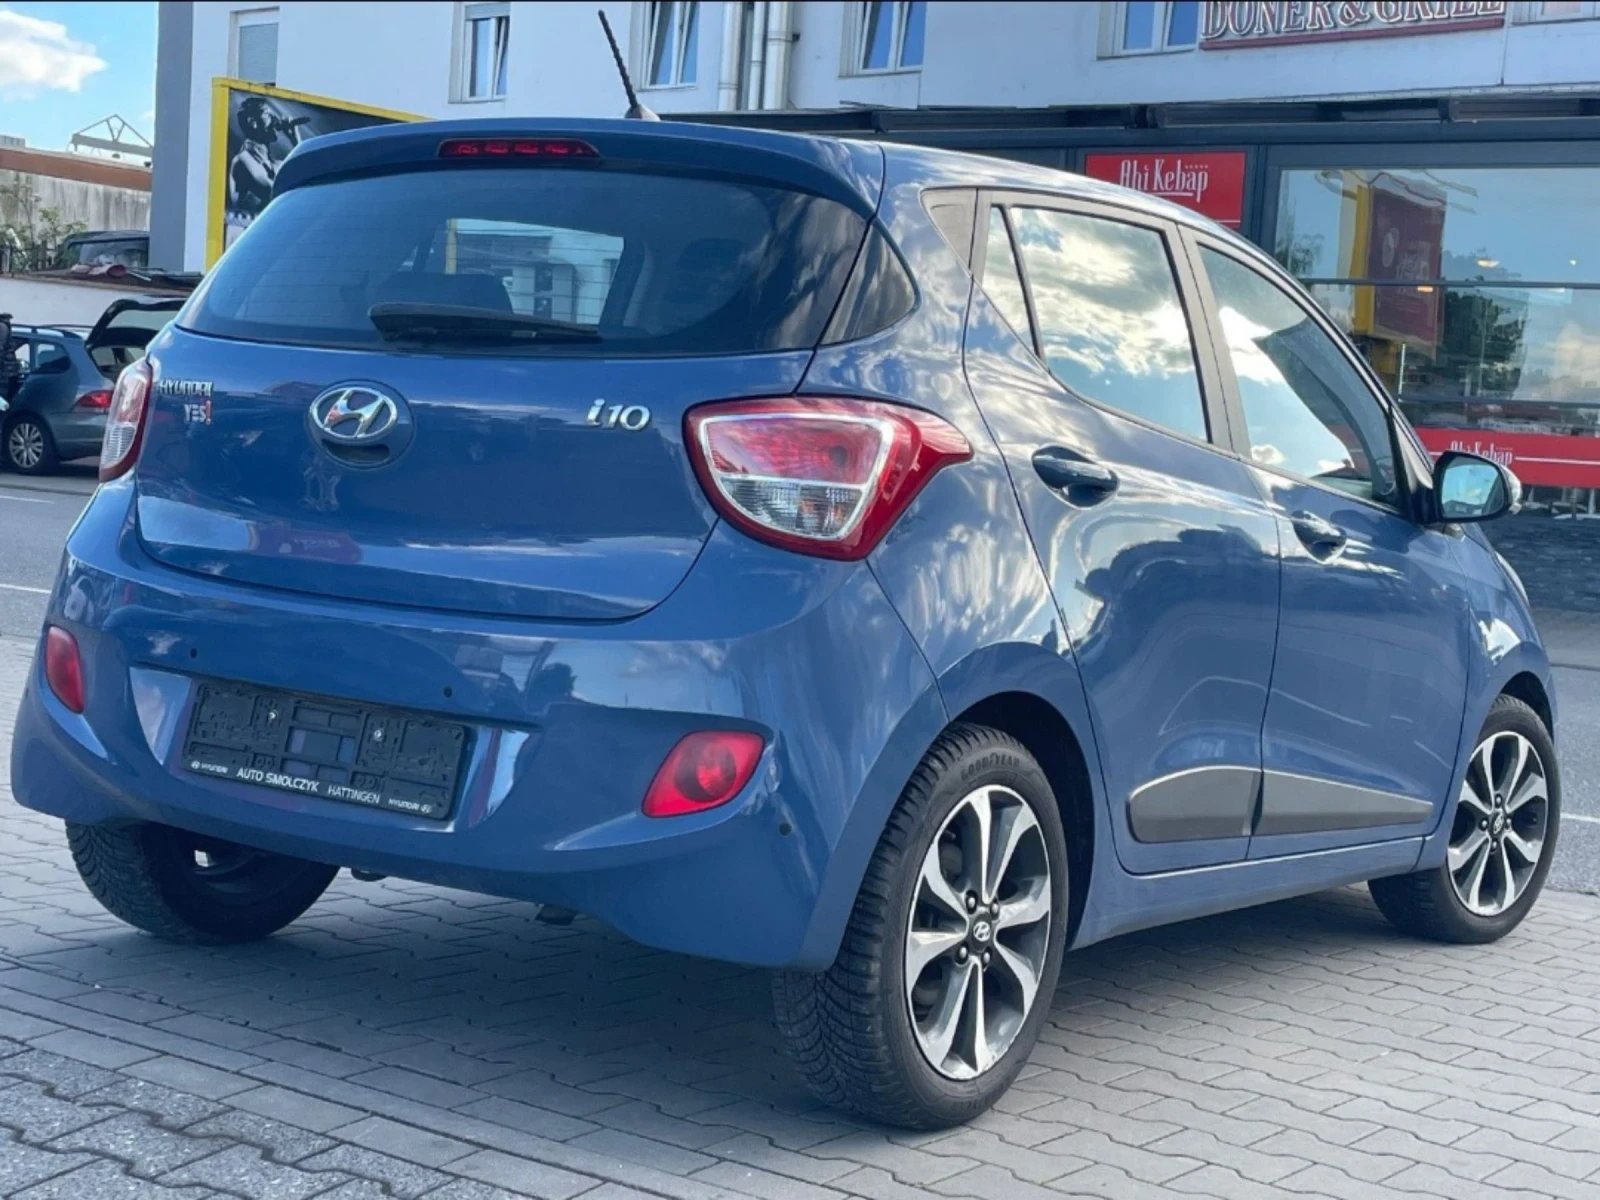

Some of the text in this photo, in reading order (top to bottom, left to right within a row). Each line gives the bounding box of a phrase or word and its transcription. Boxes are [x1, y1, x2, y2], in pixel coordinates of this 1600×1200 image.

[1152, 158, 1209, 203] Kebap
[159, 379, 213, 397] HYUNDAI
[183, 400, 212, 425] YES!
[586, 398, 650, 431] i10
[960, 751, 1020, 781] GOODYEAR
[236, 767, 264, 782] AUTO
[265, 772, 320, 793] SMOLCZYK
[327, 785, 381, 805] HATTINGEN
